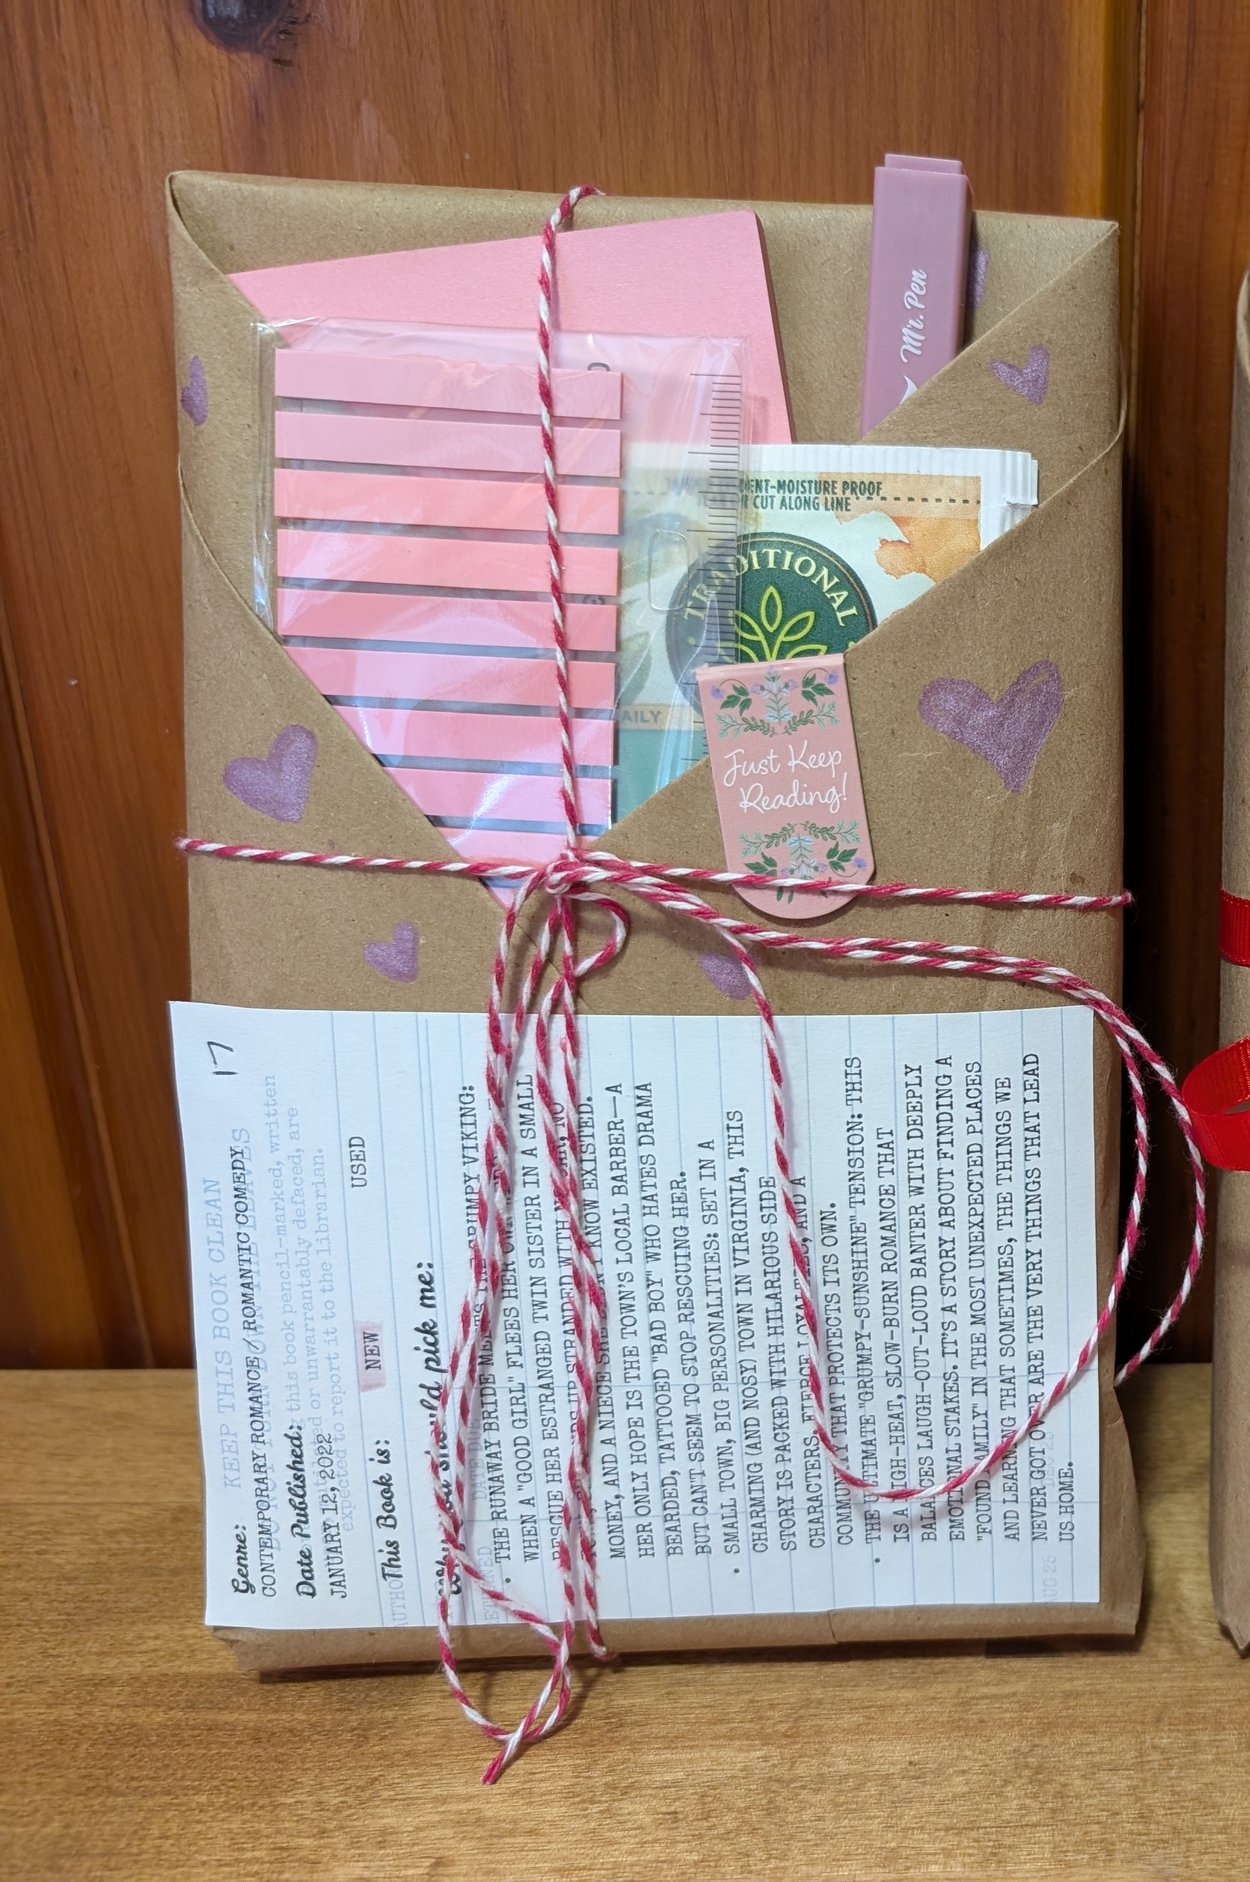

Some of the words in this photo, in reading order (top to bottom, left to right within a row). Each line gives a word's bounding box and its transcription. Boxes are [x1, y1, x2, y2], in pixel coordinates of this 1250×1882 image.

[903, 268, 928, 309] Pen
[900, 314, 926, 363] Mr.
[753, 494, 781, 510] CUT
[779, 495, 821, 512] ALONG
[823, 495, 853, 512] LINE
[841, 480, 883, 497] PROOF
[683, 548, 859, 628] TRADITIONAL
[723, 748, 782, 787] Just
[788, 739, 843, 778] Keep
[739, 771, 849, 815] Reading!
[206, 1040, 240, 1076] 17
[1021, 1053, 1040, 1105] LEAD
[263, 1076, 280, 1154] written
[634, 1083, 655, 1147] DRAMA
[725, 1110, 745, 1160] THIS
[1023, 1111, 1041, 1162] THAT
[348, 1136, 367, 1188] USED
[697, 1140, 714, 1151] A
[698, 1159, 717, 1181] IN
[229, 1147, 249, 1225] COMEDY
[639, 1154, 659, 1217] HATES
[699, 1187, 718, 1226] SET
[758, 1176, 777, 1225] SIDE
[1024, 1168, 1042, 1243] THINGS
[202, 1178, 225, 1264] CLEAN
[268, 1161, 297, 1314] pencil-marked,
[612, 1203, 633, 1265] LOCAL
[728, 1167, 750, 1268] VIRGINIA,
[642, 1224, 661, 1264] WHO
[236, 1232, 257, 1331] ROMANTIC
[416, 1262, 436, 1309] me:
[734, 1274, 752, 1297] IN
[761, 1231, 784, 1337] HILARIOUS
[1025, 1249, 1043, 1300] VERY
[208, 1273, 230, 1341] BOOK
[617, 1271, 637, 1340] TOWN'S
[703, 1233, 728, 1392] PERSONALITIES:
[736, 1303, 755, 1352] TOWN
[1026, 1305, 1044, 1344] THE
[280, 1320, 297, 1365] book
[362, 1331, 381, 1371] NEW
[413, 1319, 447, 1374] pick
[622, 1346, 641, 1384] THE
[768, 1343, 787, 1391] WITH
[214, 1350, 235, 1414] THIS
[285, 1371, 301, 1413] this
[738, 1359, 759, 1411] NOSY)
[1027, 1350, 1045, 1387] ARE
[245, 1356, 265, 1445] ROMANCE
[625, 1390, 643, 1411] IS
[652, 1369, 675, 1464] TATTOOED
[712, 1400, 731, 1433] BIG
[368, 1440, 391, 1465] is:
[627, 1417, 647, 1465] HOPE
[743, 1417, 762, 1456] (AND
[770, 1396, 791, 1464] PACKED
[219, 1423, 241, 1489] KEEP
[316, 1433, 335, 1480] 2022
[716, 1439, 736, 1493] TOWN,
[775, 1469, 794, 1491] IS
[284, 1426, 310, 1539] Published:
[321, 1486, 340, 1515] 12,
[372, 1473, 397, 1530] Book
[630, 1471, 651, 1518] ONLY
[746, 1462, 768, 1553] CHARMING
[1058, 1462, 1074, 1516] HOME.
[251, 1451, 276, 1597] CONTEMPORARY
[660, 1470, 683, 1557] BEARDED,
[720, 1498, 740, 1554] SMALL
[776, 1496, 797, 1551] STORY
[1058, 1521, 1074, 1542] US
[231, 1525, 256, 1595] Genre:
[322, 1521, 347, 1599] JANUARY
[378, 1540, 403, 1581] This
[635, 1522, 655, 1558] HER
[295, 1548, 317, 1598] Date
